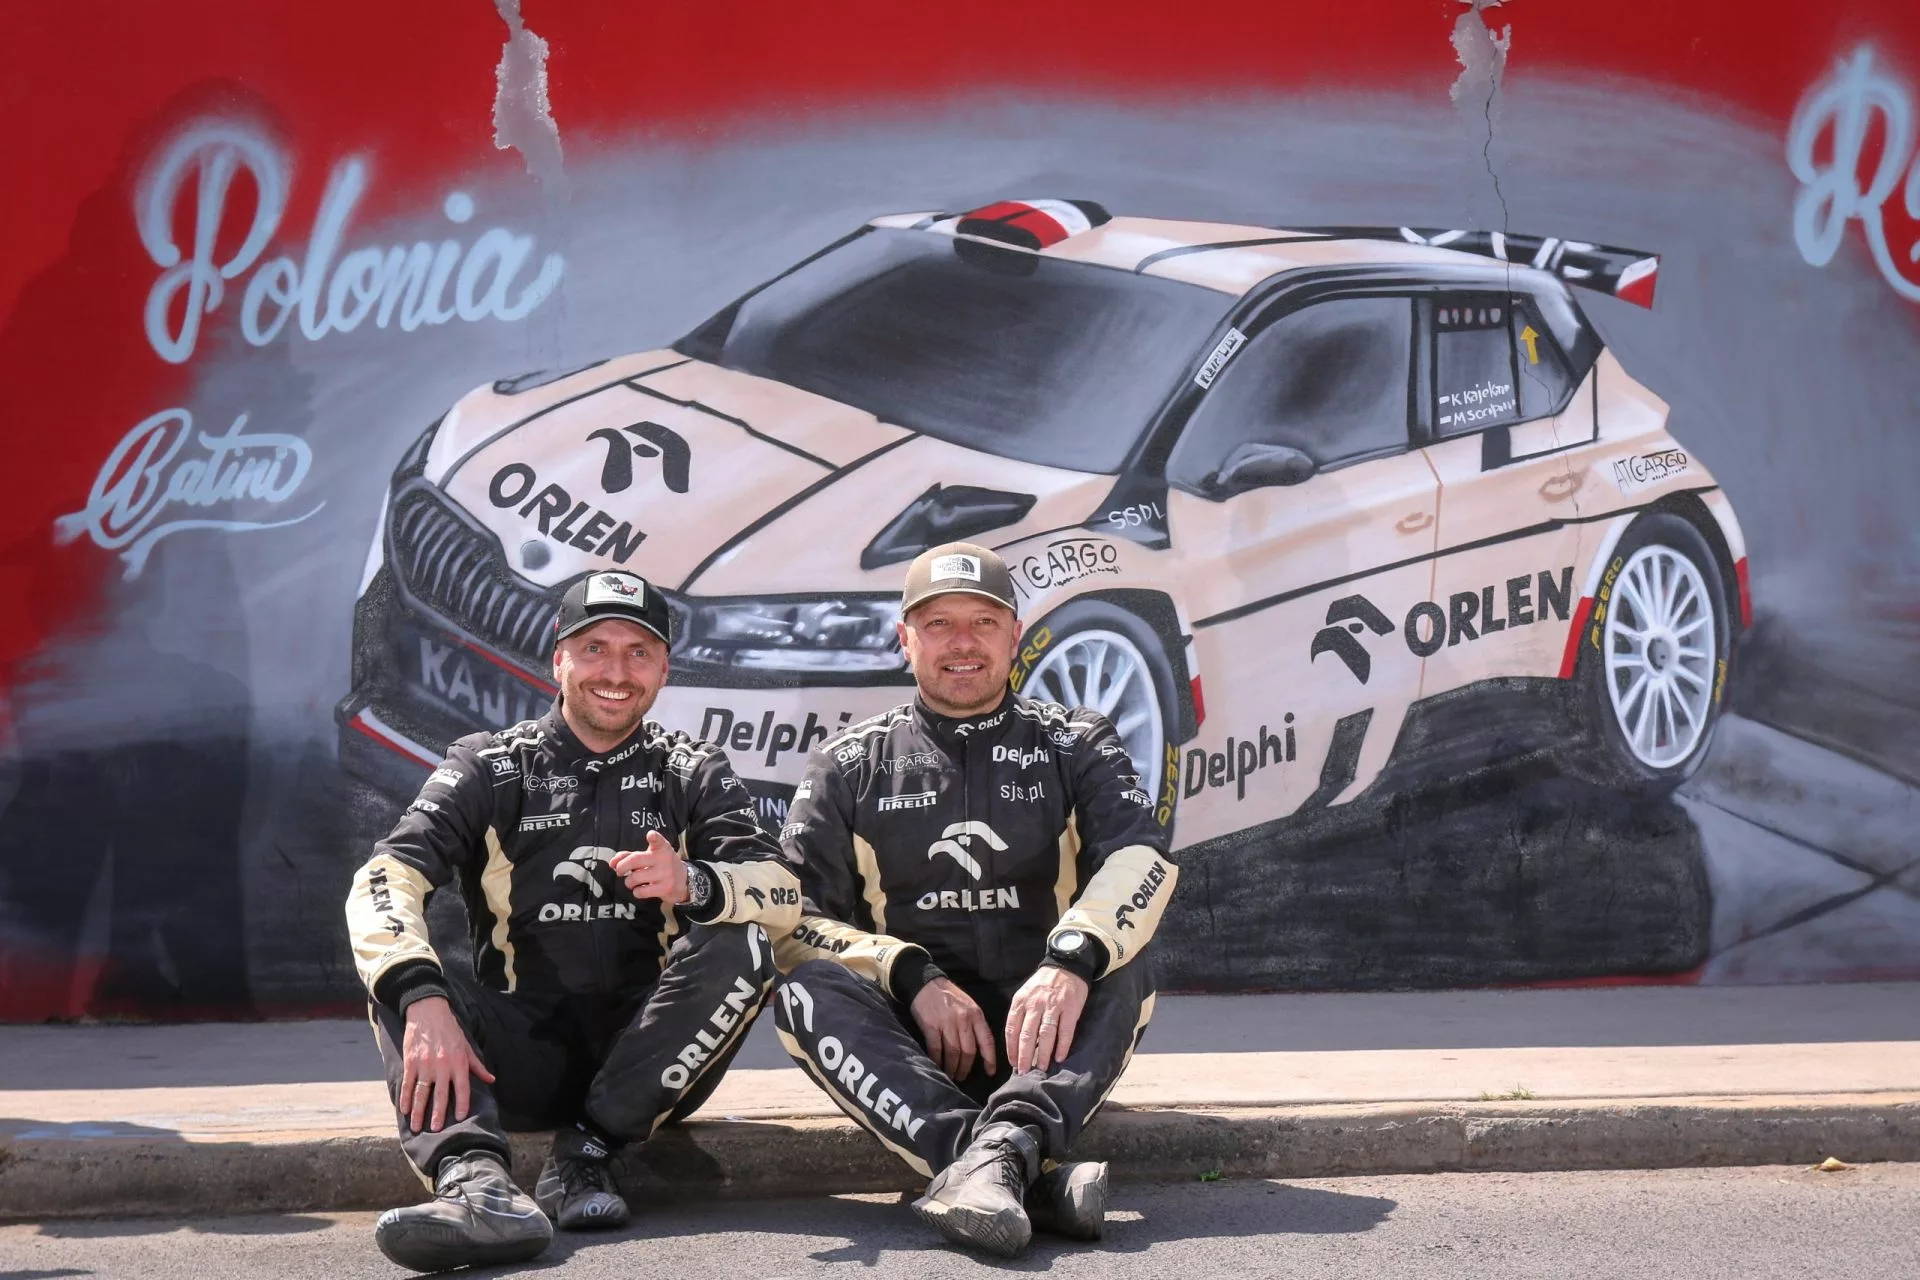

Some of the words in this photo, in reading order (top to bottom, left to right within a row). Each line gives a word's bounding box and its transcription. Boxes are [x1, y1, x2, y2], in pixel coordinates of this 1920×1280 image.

[136, 117, 563, 363] Polonia
[489, 463, 648, 564] ORLEN
[1404, 566, 1575, 657] ORLEN
[992, 745, 1050, 770] Delphi
[1184, 712, 1296, 802] Delphi
[877, 790, 937, 813] PIRELLI
[1000, 781, 1045, 803] sjs.pl
[538, 901, 636, 924] ORLEN
[916, 886, 1021, 912] ORLEN
[1132, 861, 1167, 909] ORLEN
[660, 975, 756, 1090] ORLEN
[817, 1035, 926, 1141] ORLEN
